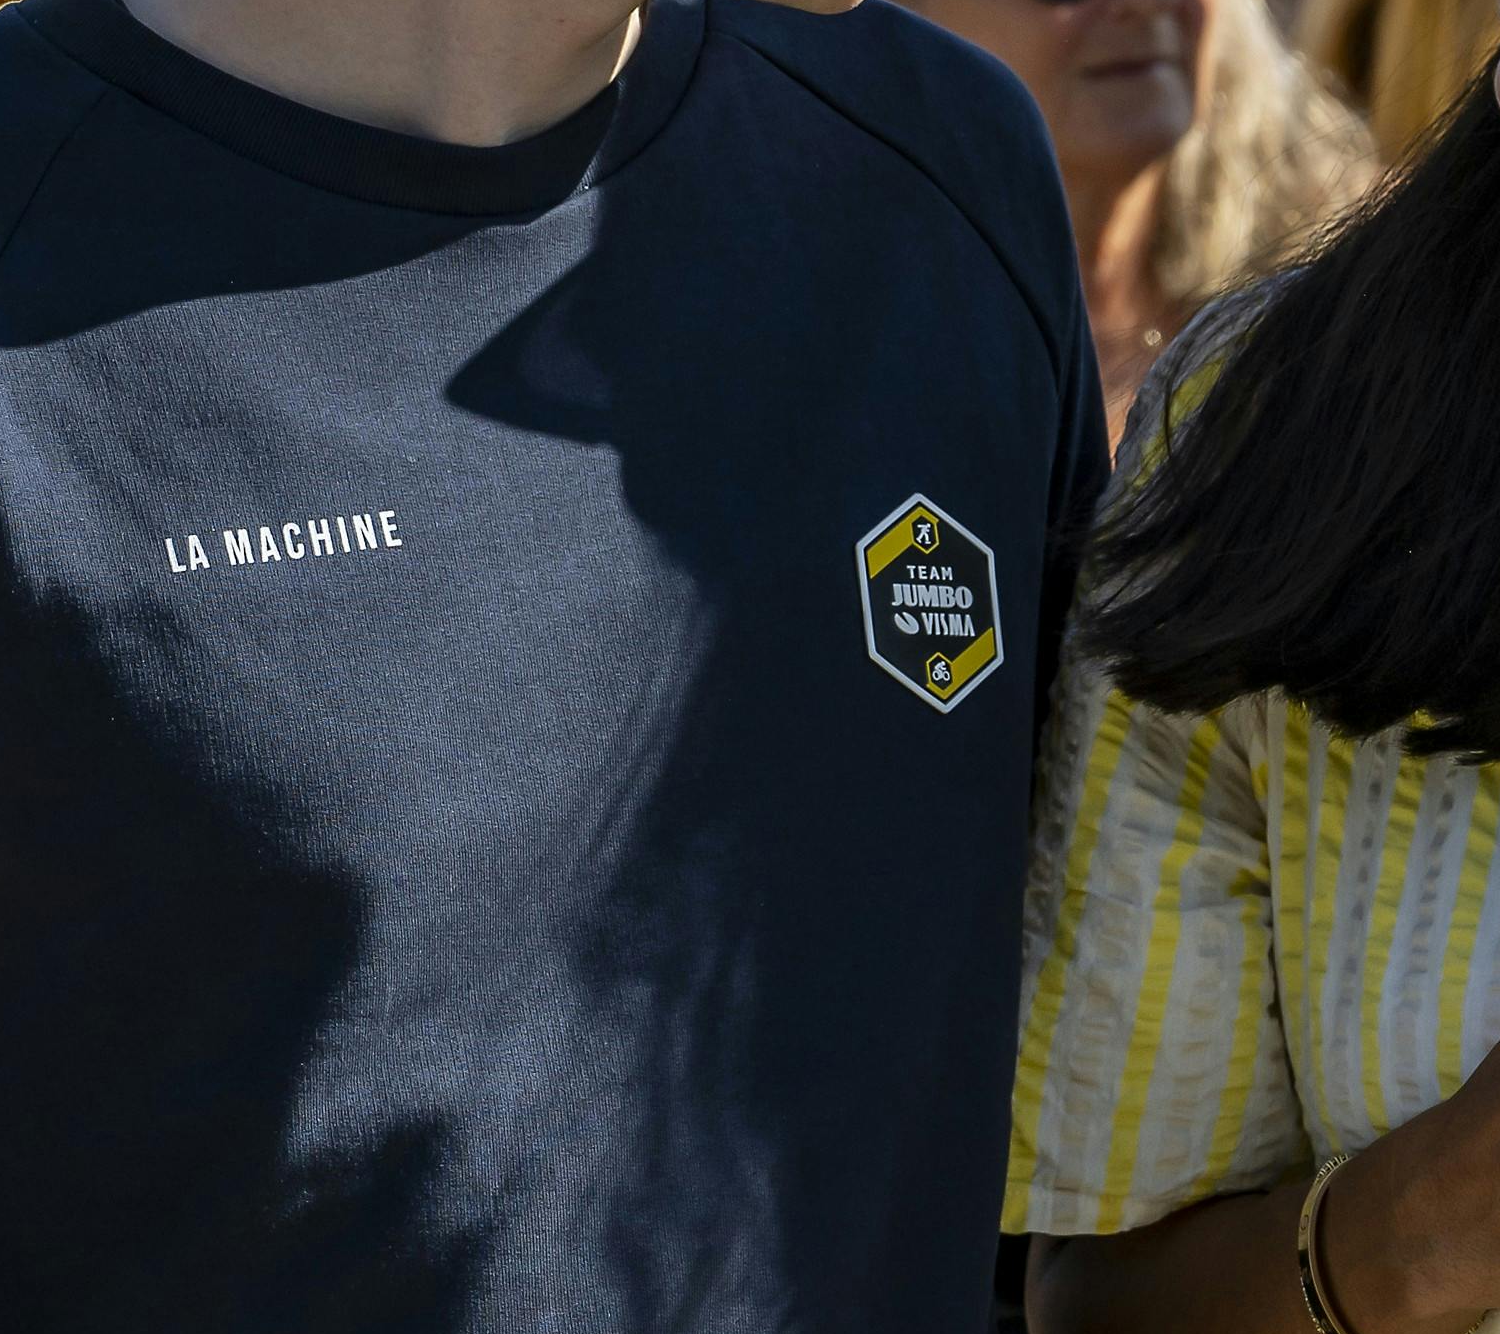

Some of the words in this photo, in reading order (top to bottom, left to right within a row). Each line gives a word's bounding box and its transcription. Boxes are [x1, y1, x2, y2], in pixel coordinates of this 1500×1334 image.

[164, 534, 211, 573] LA
[222, 510, 403, 566] MACHINE
[906, 565, 954, 581] TEAM
[891, 583, 974, 610] JUMBO
[920, 612, 976, 637] VISMA
